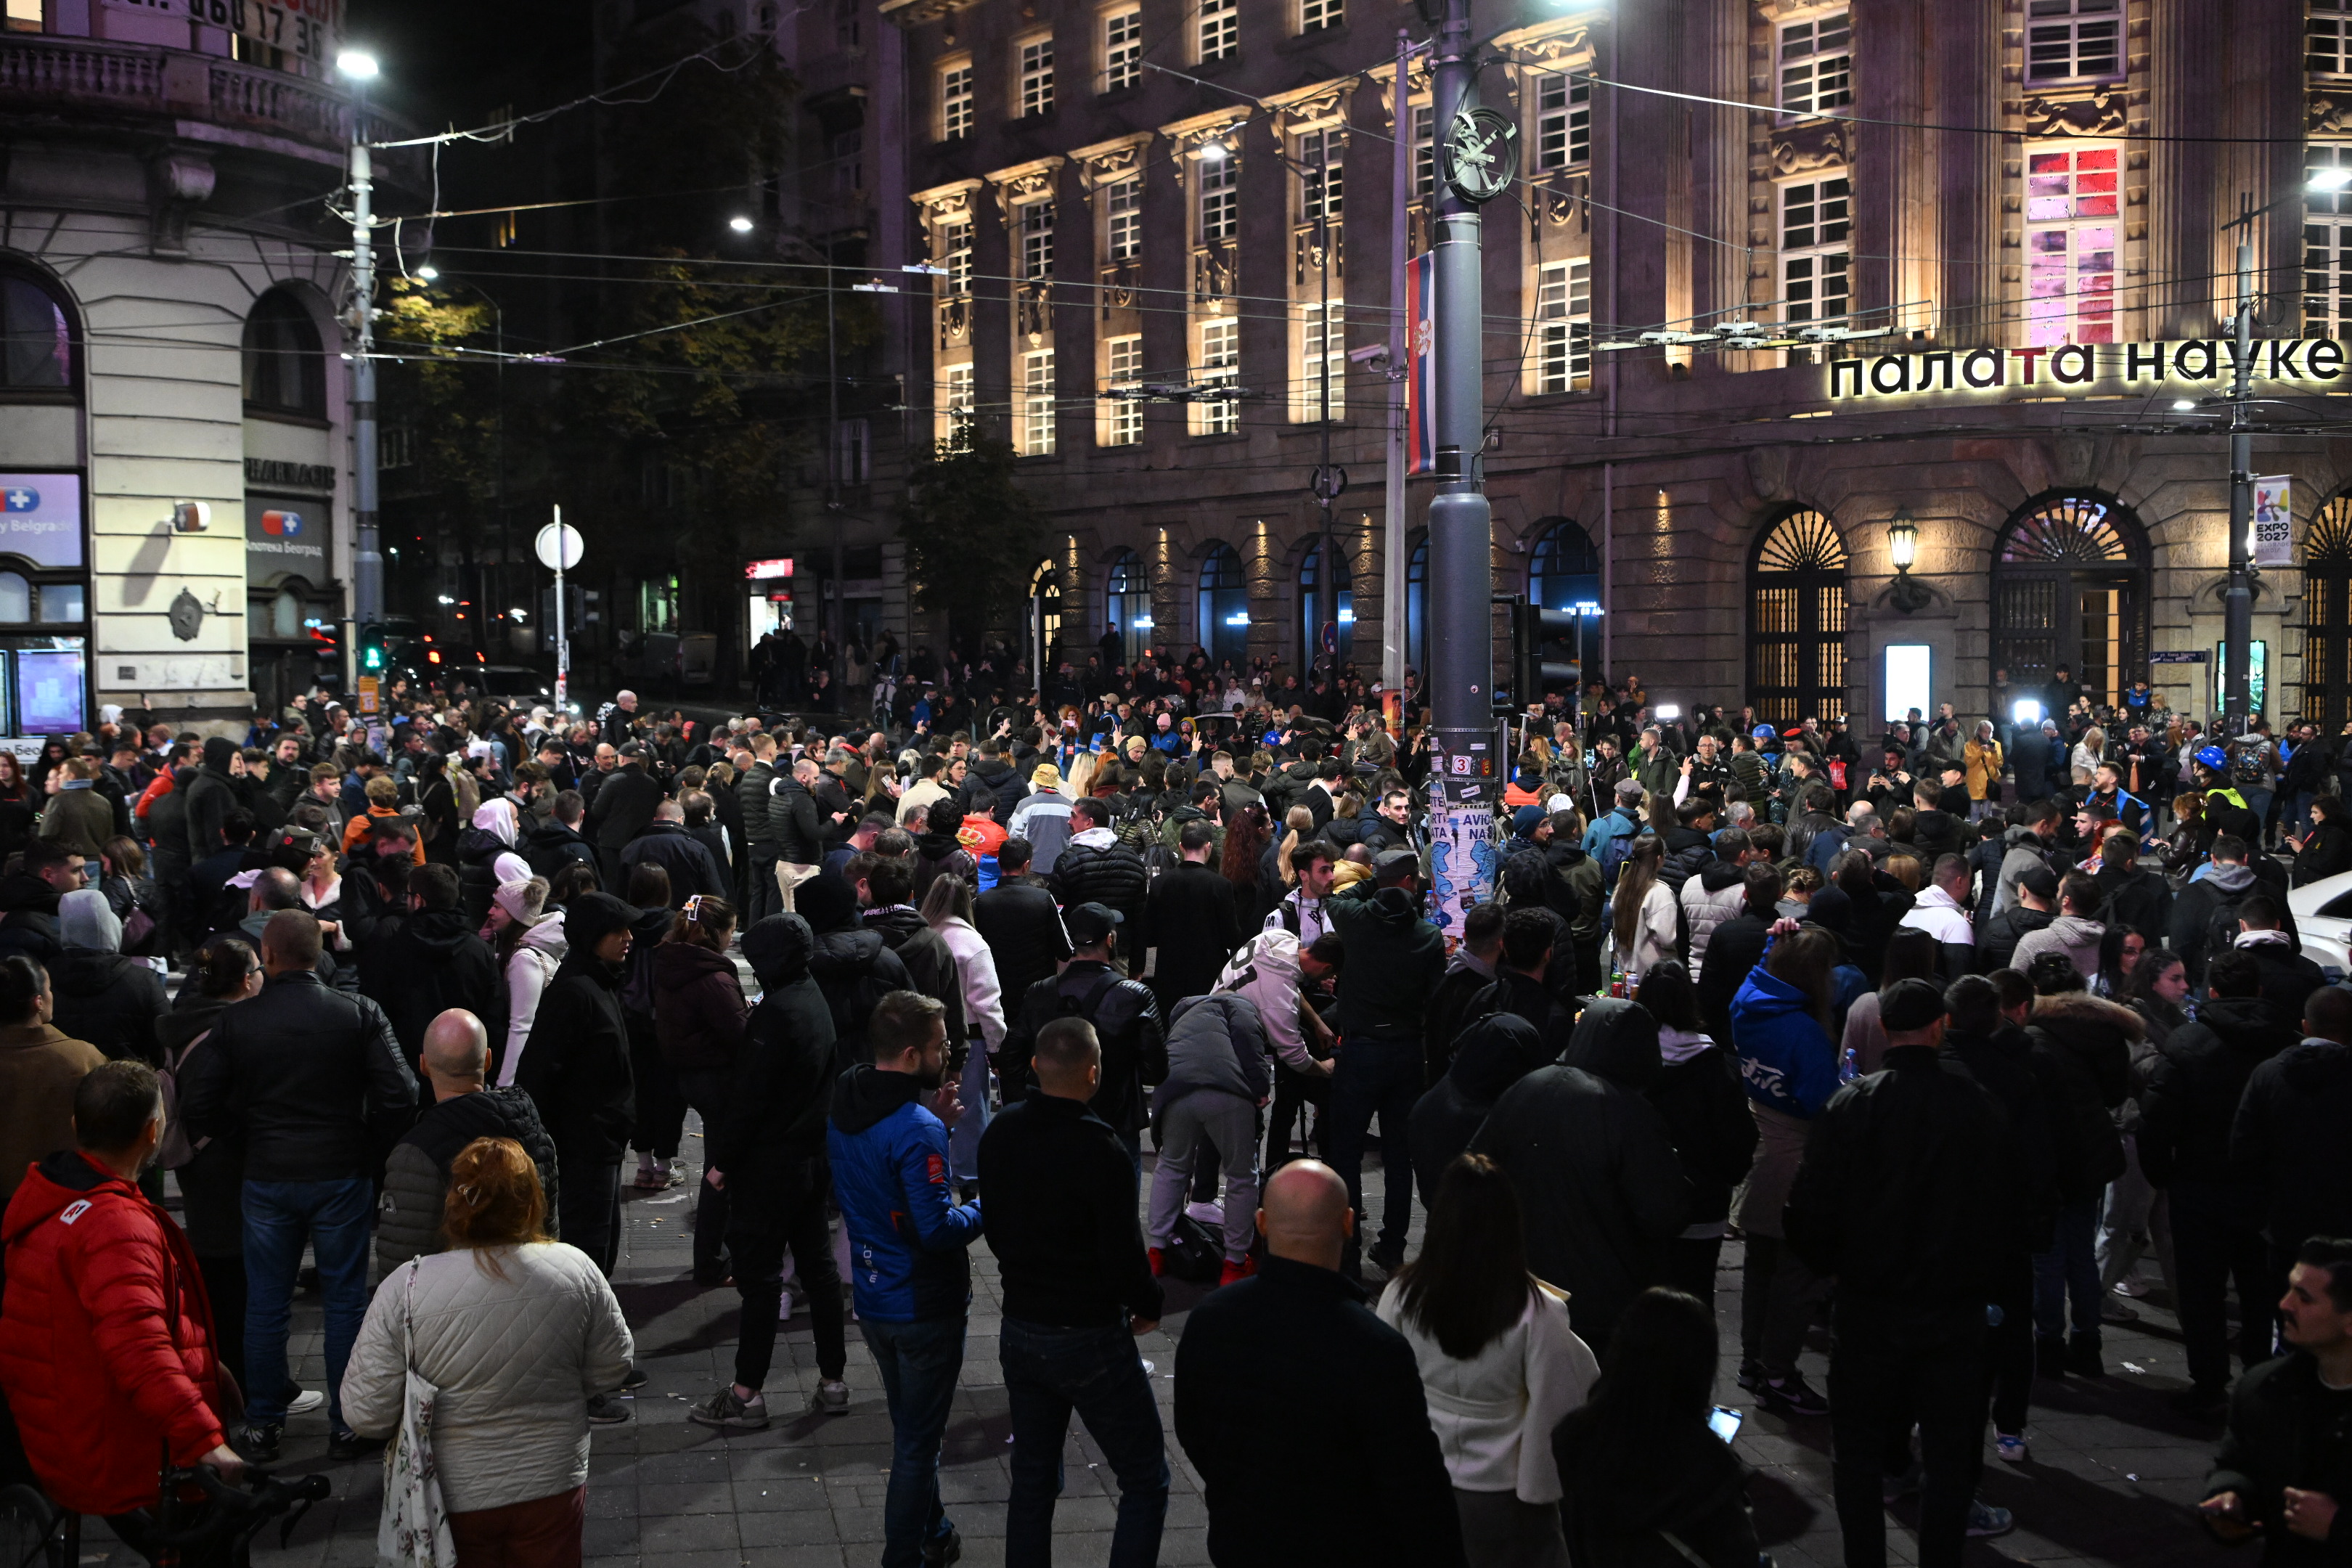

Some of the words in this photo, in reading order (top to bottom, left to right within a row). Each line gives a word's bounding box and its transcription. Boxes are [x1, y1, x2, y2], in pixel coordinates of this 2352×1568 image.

[256, 2, 283, 44] 17
[1831, 343, 2094, 398] палата
[2127, 339, 2344, 381] науке
[2256, 522, 2289, 532] EXPO
[2256, 531, 2289, 542] 2027
[1457, 759, 1466, 772] 3
[1463, 814, 1490, 825] AVIO
[1469, 828, 1486, 839] NA
